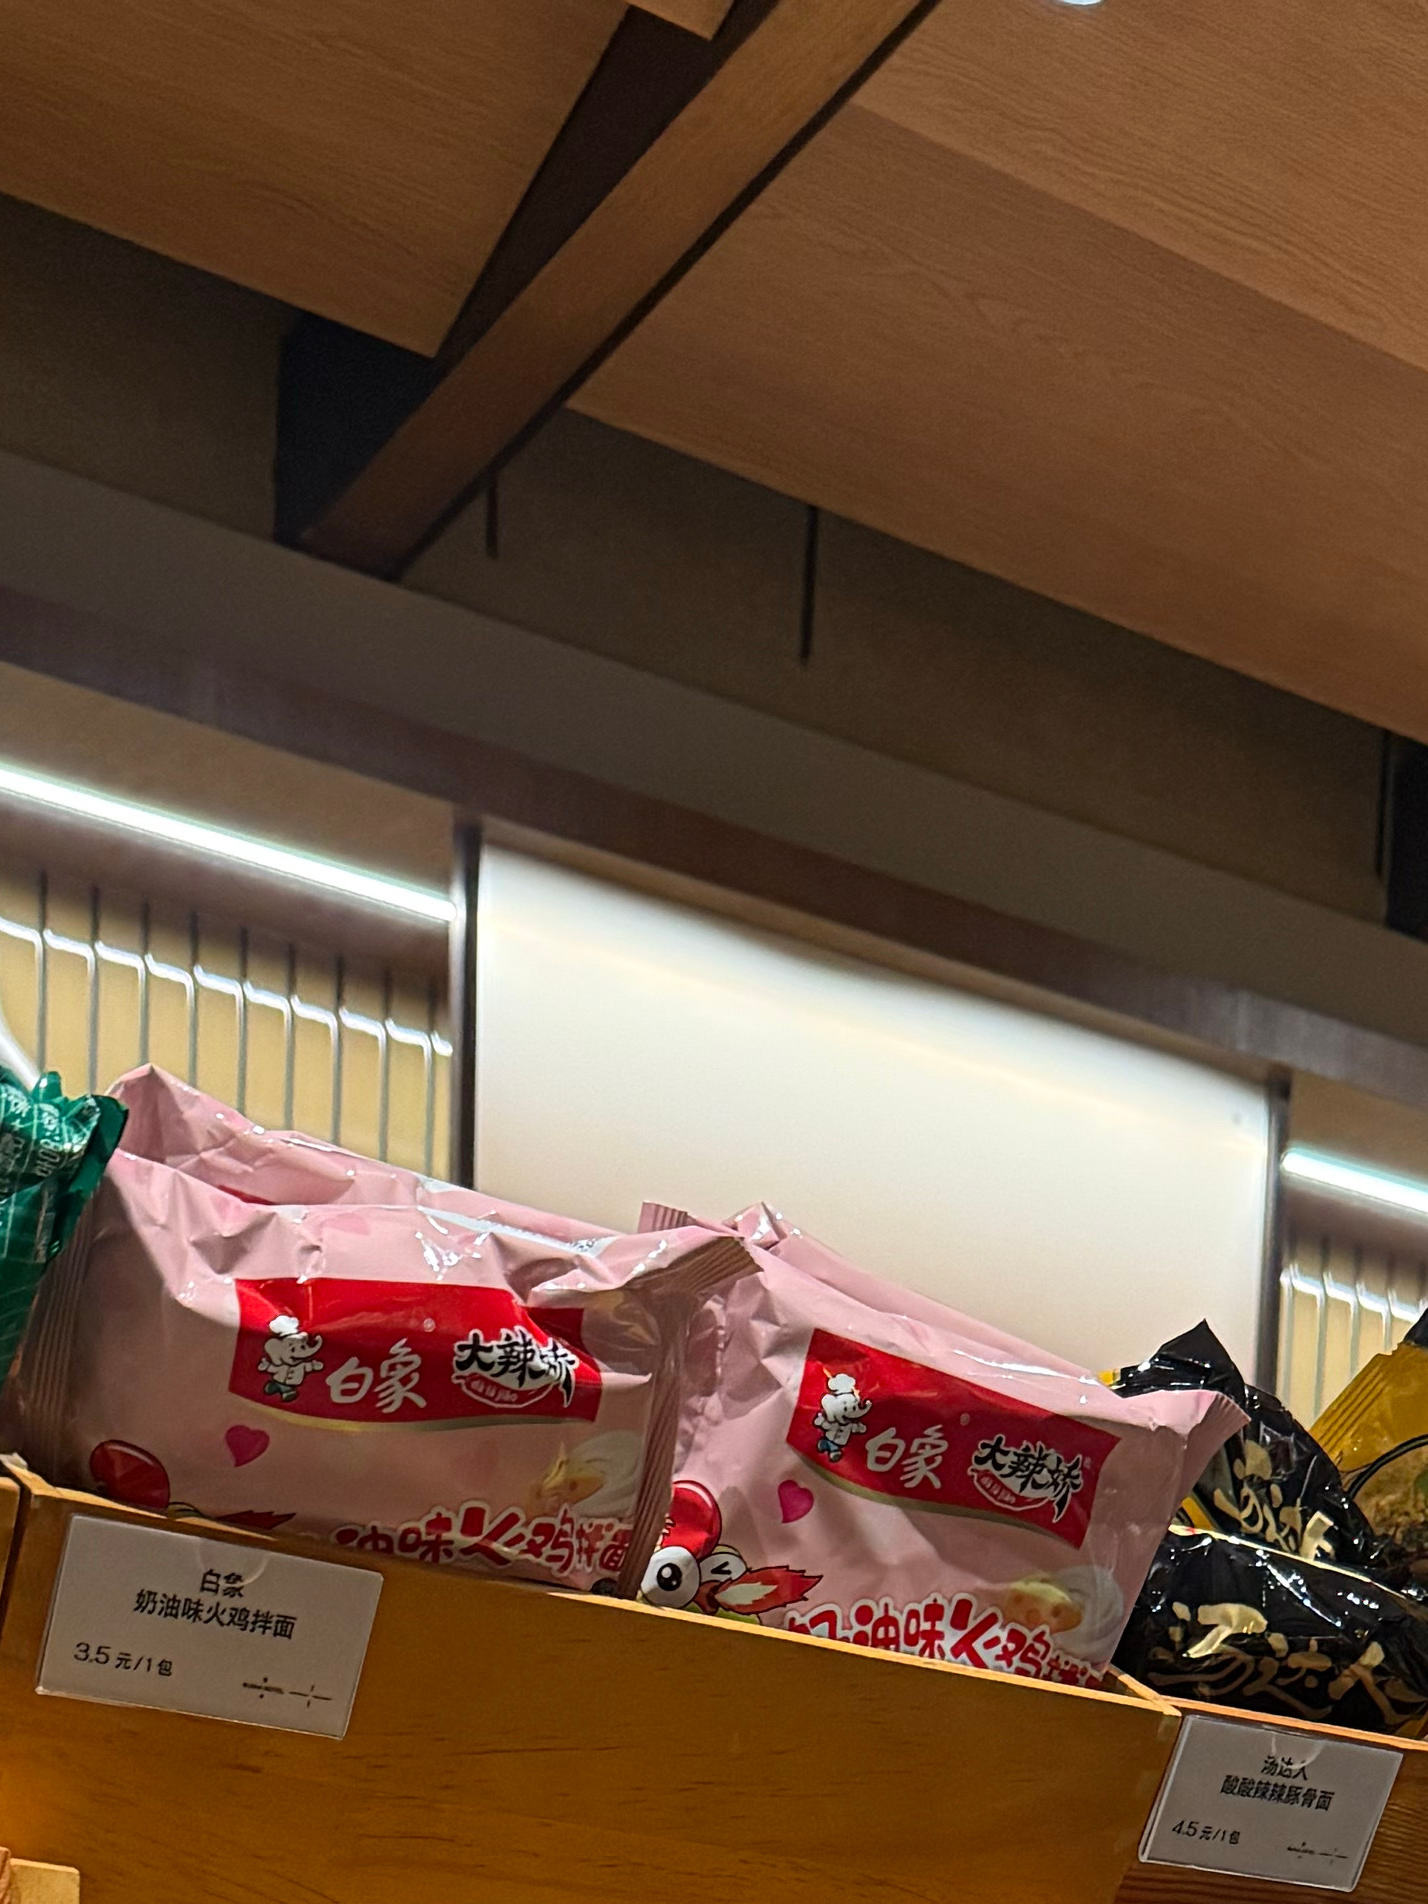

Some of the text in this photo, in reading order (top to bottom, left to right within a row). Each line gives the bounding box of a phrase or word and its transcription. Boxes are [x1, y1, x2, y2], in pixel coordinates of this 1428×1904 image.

[326, 1339, 426, 1414] 白象
[866, 1425, 948, 1489] 白象
[200, 1570, 244, 1598] 白象
[134, 1589, 297, 1639] 奶油味火鸡拌面
[74, 1642, 111, 1665] 3.5
[1260, 1755, 1308, 1781] 汤达人
[1220, 1775, 1335, 1811] 酸酸辣辣豚骨面
[1172, 1821, 1198, 1838] 4.5
